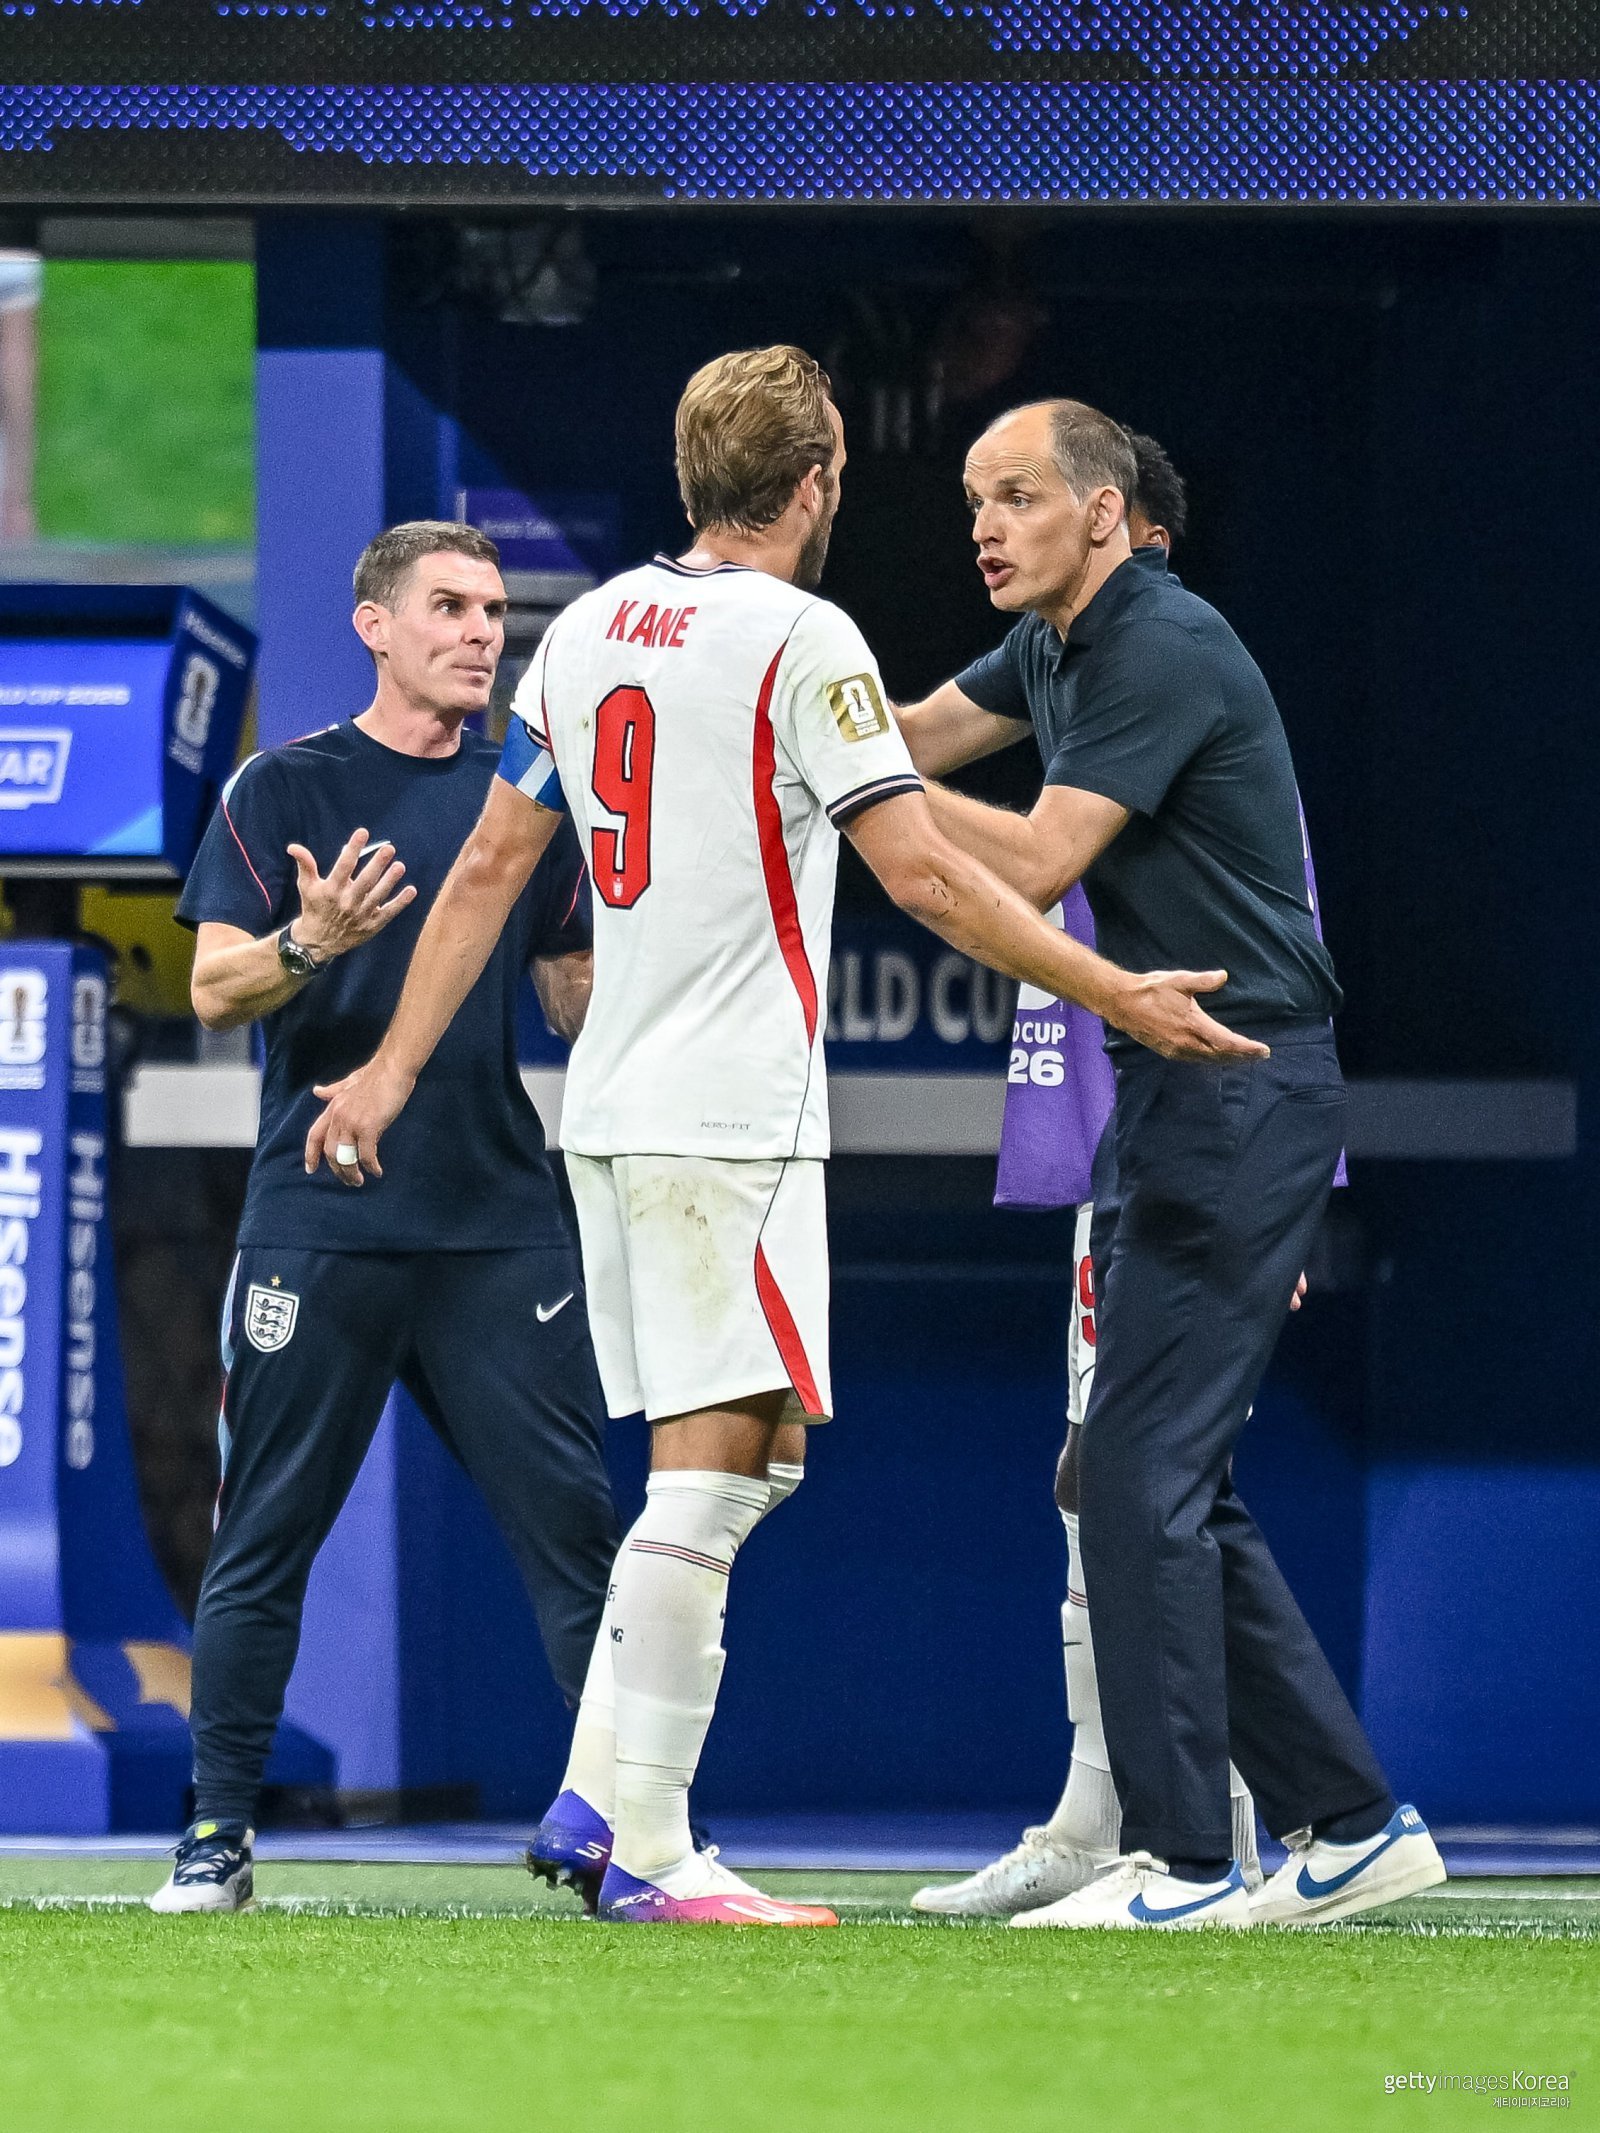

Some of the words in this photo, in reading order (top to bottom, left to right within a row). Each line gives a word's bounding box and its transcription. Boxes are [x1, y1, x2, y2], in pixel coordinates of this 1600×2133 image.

[606, 600, 697, 648] KANE
[0, 748, 53, 786] AR
[591, 684, 655, 910] 9
[928, 952, 1012, 1044] CU
[66, 1133, 104, 1471] Hisense
